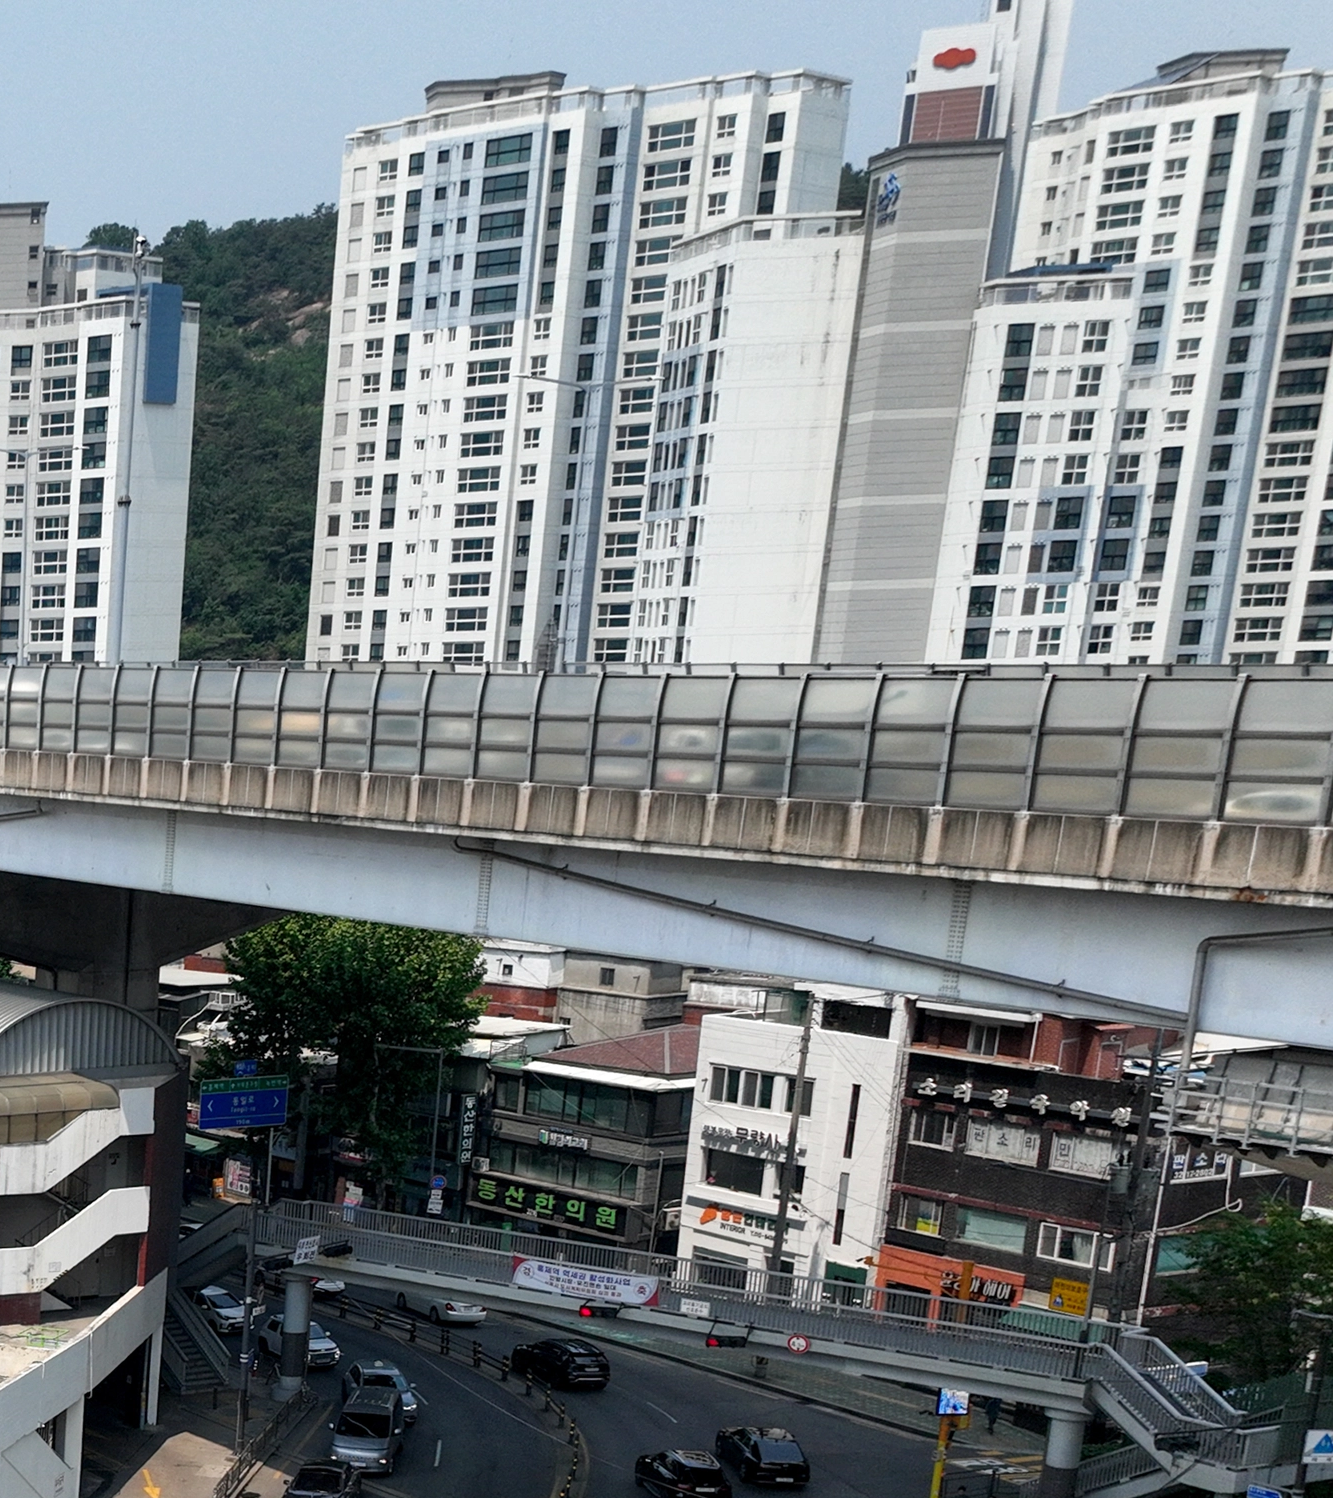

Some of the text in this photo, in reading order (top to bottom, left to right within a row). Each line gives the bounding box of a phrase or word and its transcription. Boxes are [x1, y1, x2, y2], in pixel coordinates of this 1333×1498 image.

[460, 1096, 477, 1164] 동산한의원
[736, 1127, 781, 1151] 무량사
[477, 1178, 618, 1229] 동산한의원
[720, 1222, 746, 1235] INTERIOR
